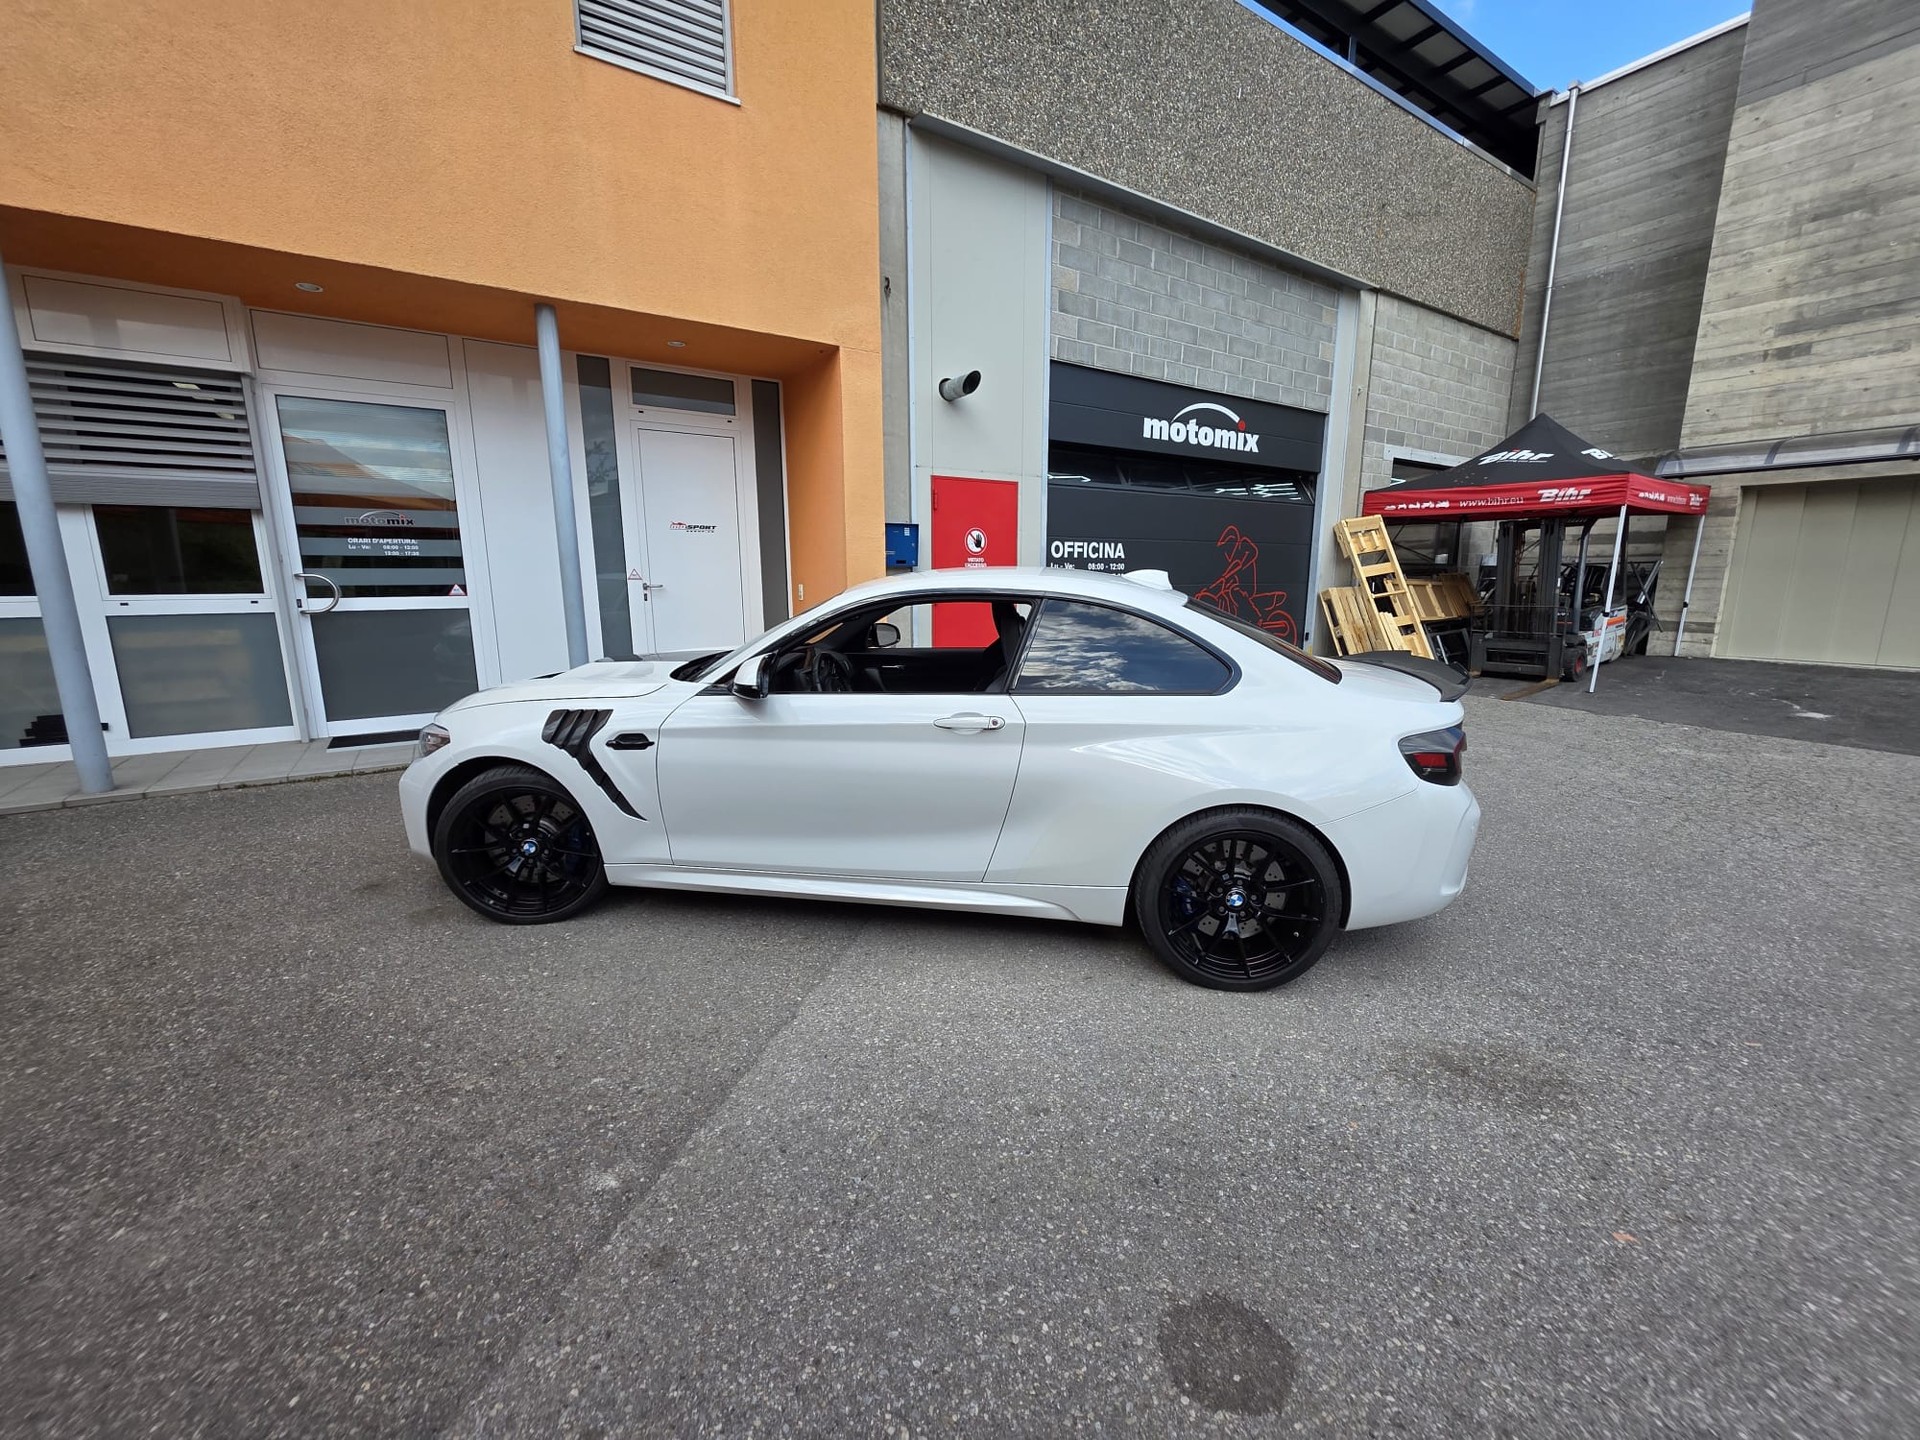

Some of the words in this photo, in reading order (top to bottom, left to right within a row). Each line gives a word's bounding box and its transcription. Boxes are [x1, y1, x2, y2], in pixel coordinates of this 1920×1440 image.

[1143, 416, 1260, 453] motomix
[1478, 449, 1555, 465] Bihr
[1580, 448, 1614, 460] Bi
[1537, 487, 1592, 502] Bihr
[1458, 496, 1525, 508] www.bihr.eu
[344, 515, 416, 526] motomix
[1050, 540, 1126, 559] OFFICINA
[1087, 562, 1104, 570] 08:00
[1110, 563, 1125, 571] 12:00
